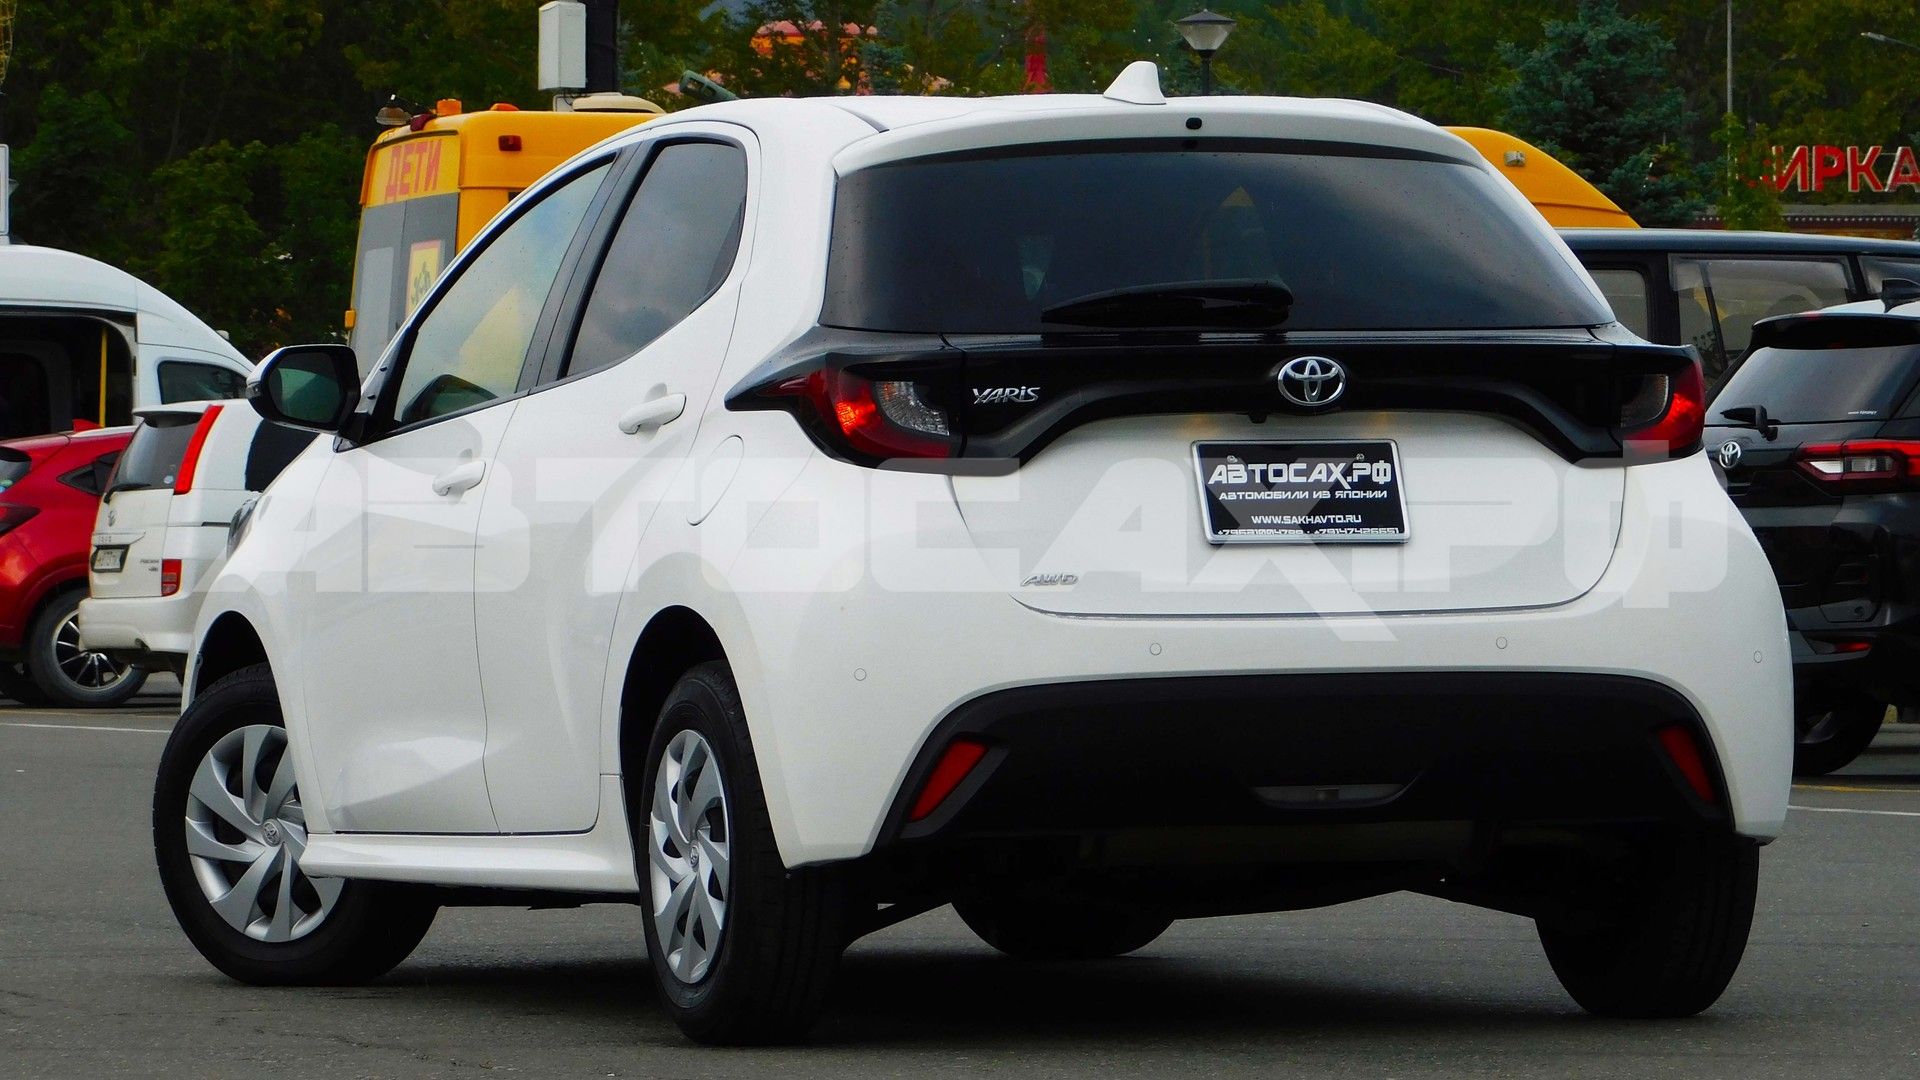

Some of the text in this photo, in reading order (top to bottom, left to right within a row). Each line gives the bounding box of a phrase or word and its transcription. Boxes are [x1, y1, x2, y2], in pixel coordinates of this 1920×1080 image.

[385, 140, 442, 202] ДЕТИ
[1735, 144, 1920, 193] ИРКА
[1208, 460, 1391, 489] АВТОСАХ.РФ
[1219, 490, 1387, 500] АВТОМОБИЛИ ИЗ ЯПОНИИ
[1251, 514, 1362, 524] WWW.SAKHAVTO.RU
[1020, 573, 1078, 587] AWD
